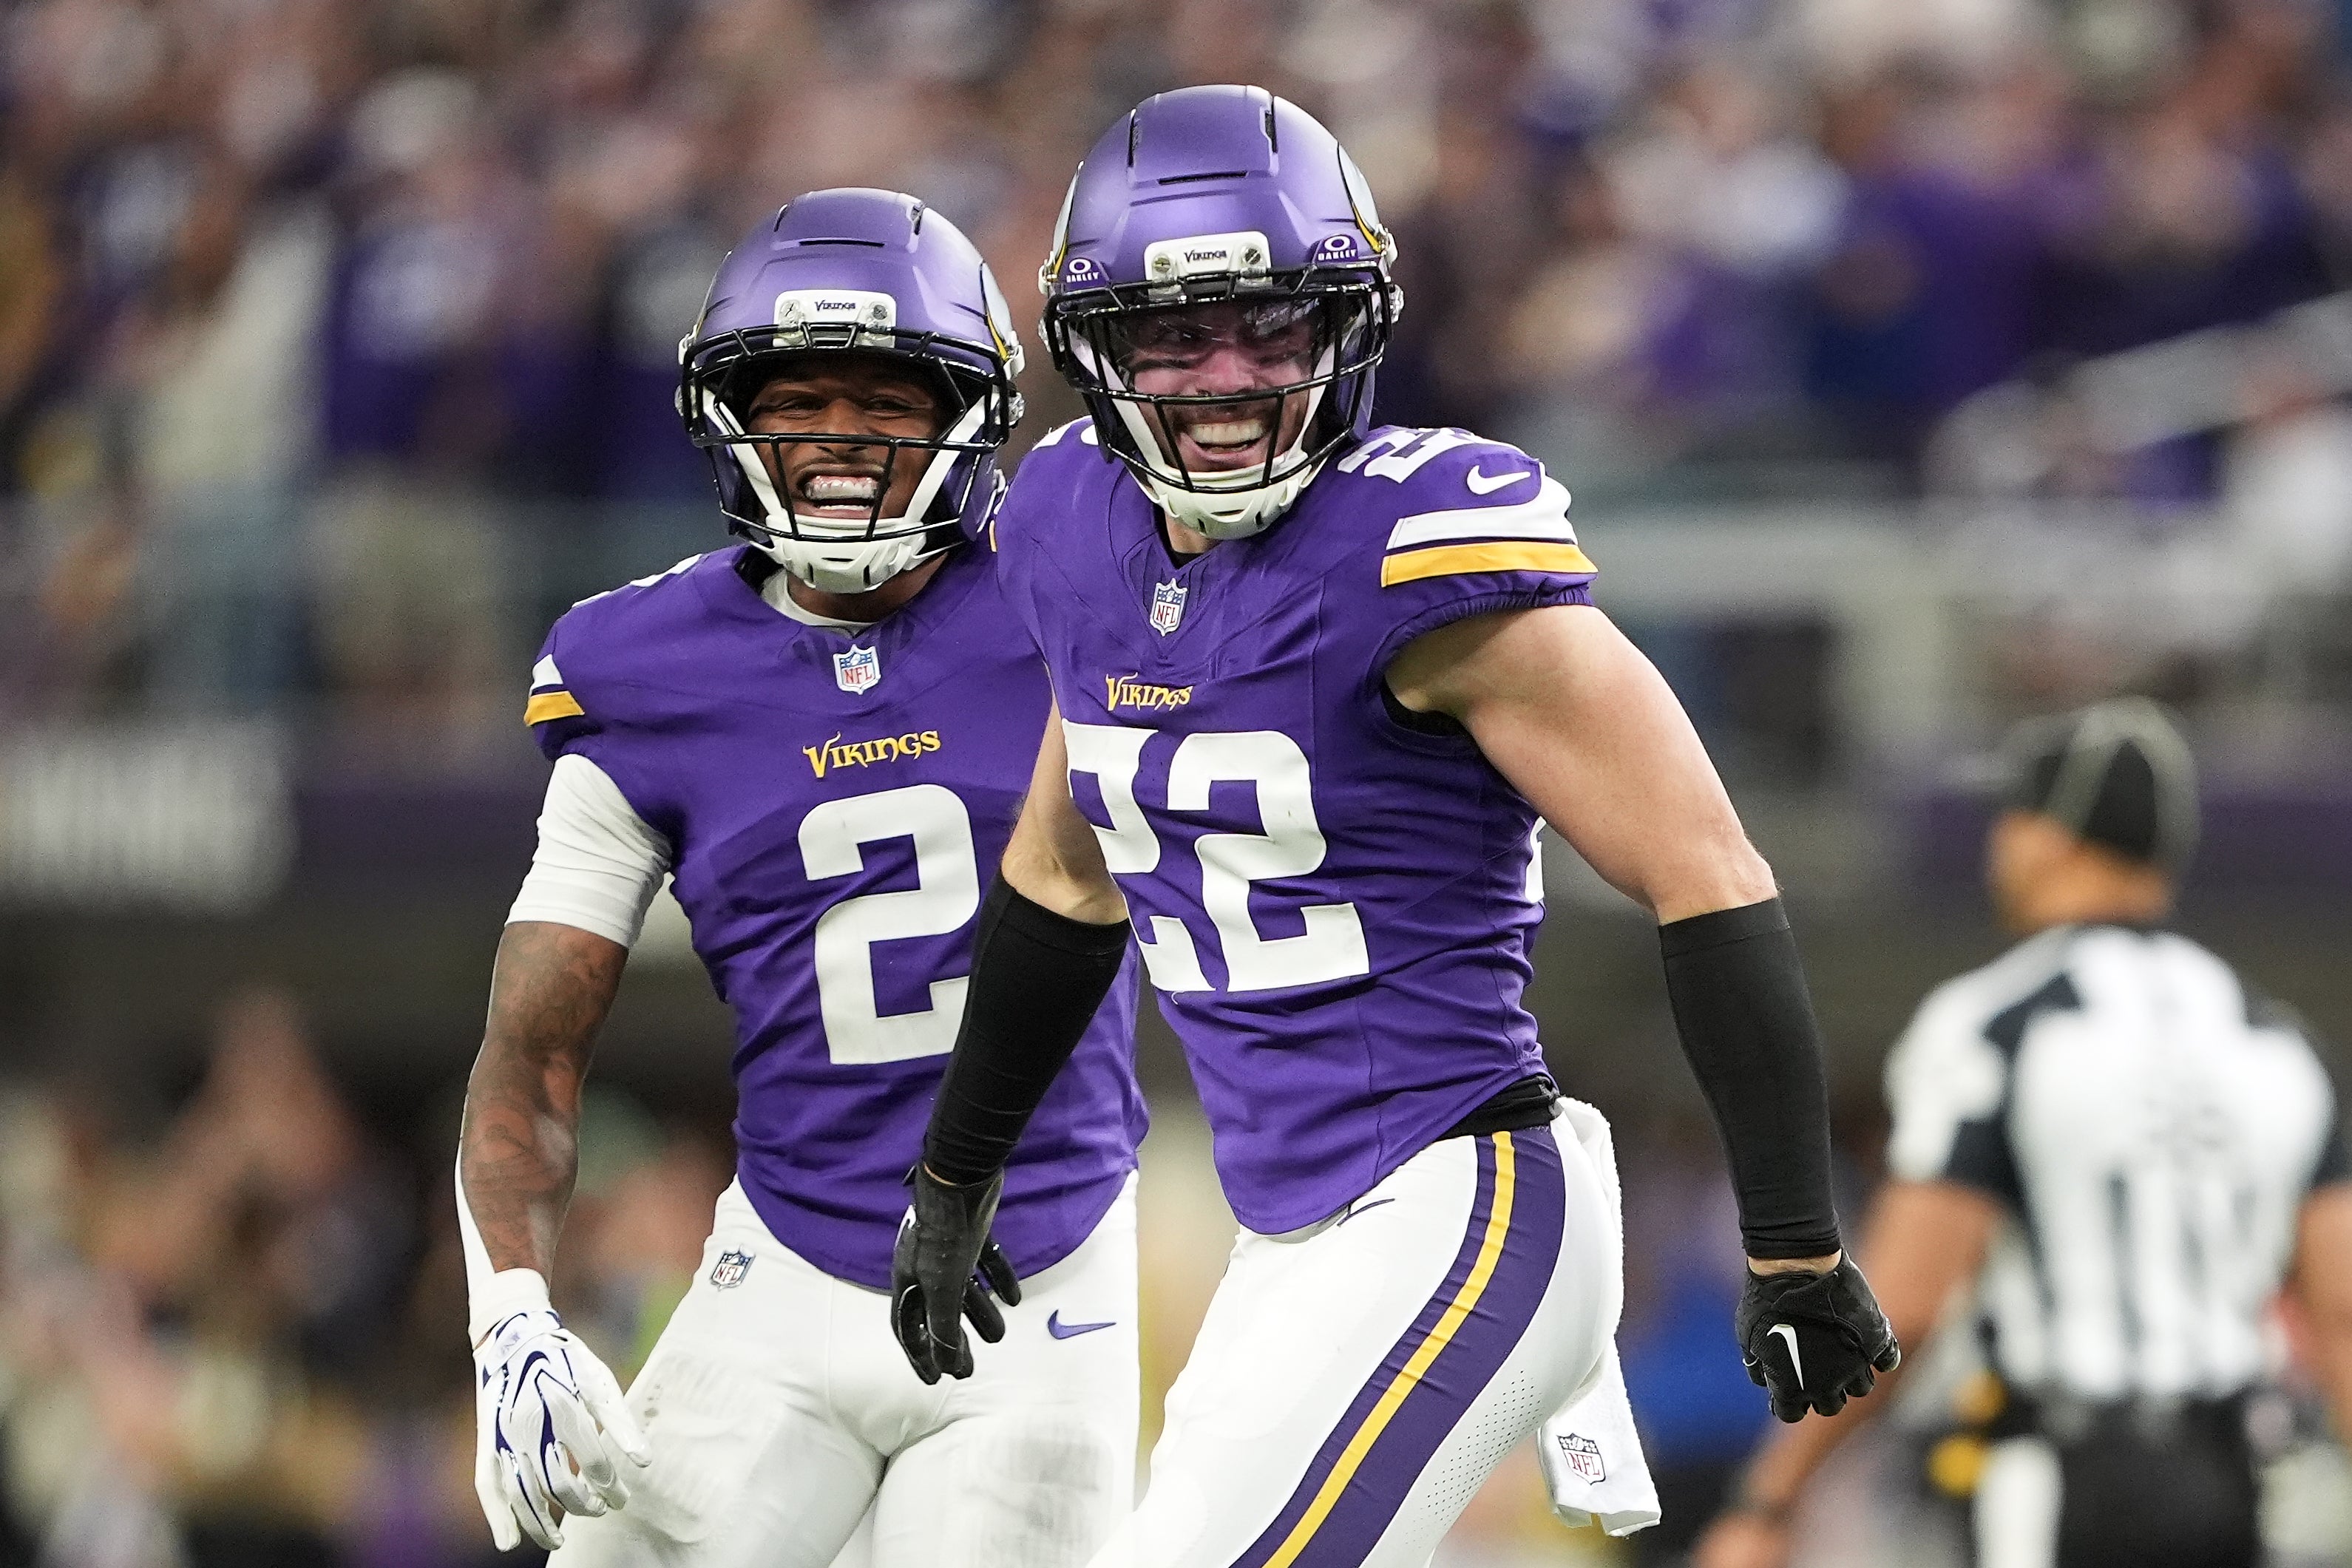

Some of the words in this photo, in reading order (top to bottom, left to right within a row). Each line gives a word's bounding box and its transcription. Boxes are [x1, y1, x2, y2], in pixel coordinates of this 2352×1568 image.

[1156, 604, 1176, 625] NFL
[844, 665, 872, 685] NFL
[1105, 671, 1194, 712] VIKINGS
[802, 730, 942, 778] VIKINGS
[798, 783, 980, 1065] 2
[715, 1265, 739, 1283] NFL
[1568, 1452, 1601, 1476] NFL
